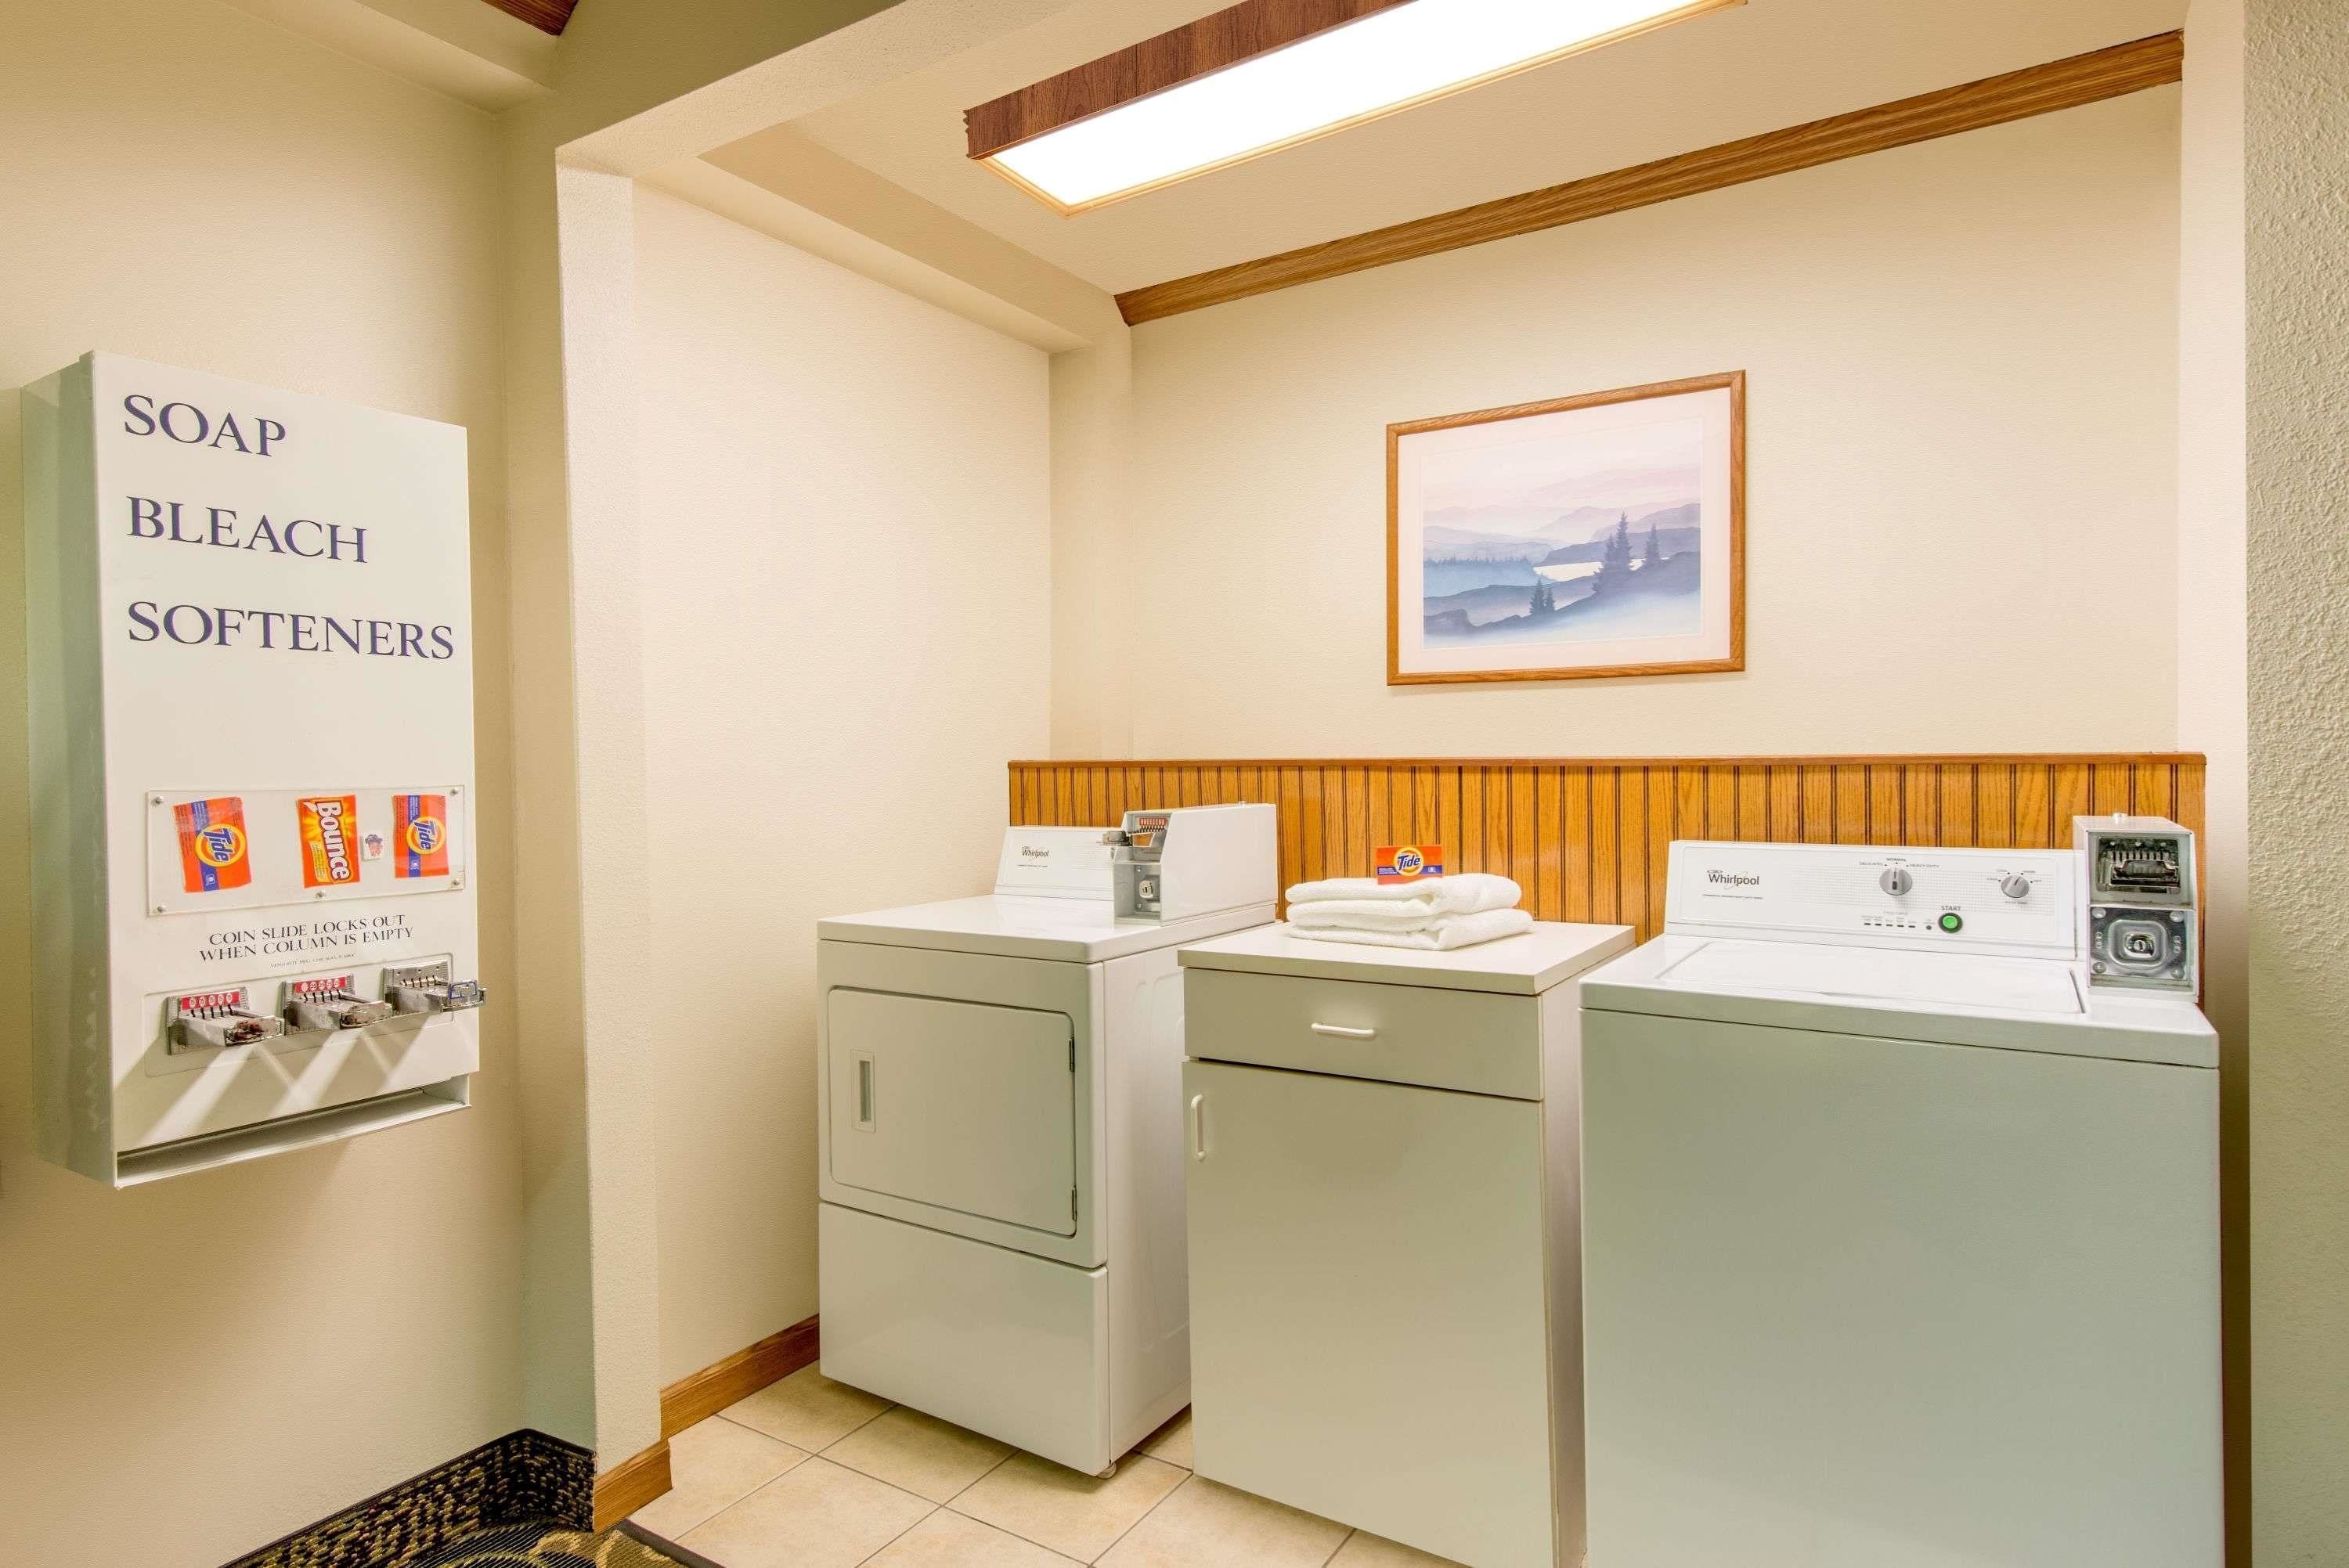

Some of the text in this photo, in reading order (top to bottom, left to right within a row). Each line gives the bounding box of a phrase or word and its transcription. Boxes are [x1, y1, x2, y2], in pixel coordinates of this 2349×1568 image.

[124, 394, 287, 457] SOAP
[126, 496, 369, 564] BLEACH
[128, 600, 454, 660] SOFTENERS
[201, 827, 234, 862] Tide
[413, 820, 436, 850] Tide
[1022, 849, 1049, 859] Whirlpool
[1396, 853, 1421, 871] Tide
[1707, 874, 1760, 887] Whirlpool
[200, 944, 257, 961] WHEN
[263, 935, 337, 954] COLUMN
[345, 933, 356, 945] IS
[363, 926, 413, 943] EMPTY
[209, 914, 406, 946] COIN SLIDE LOCKS OUT
